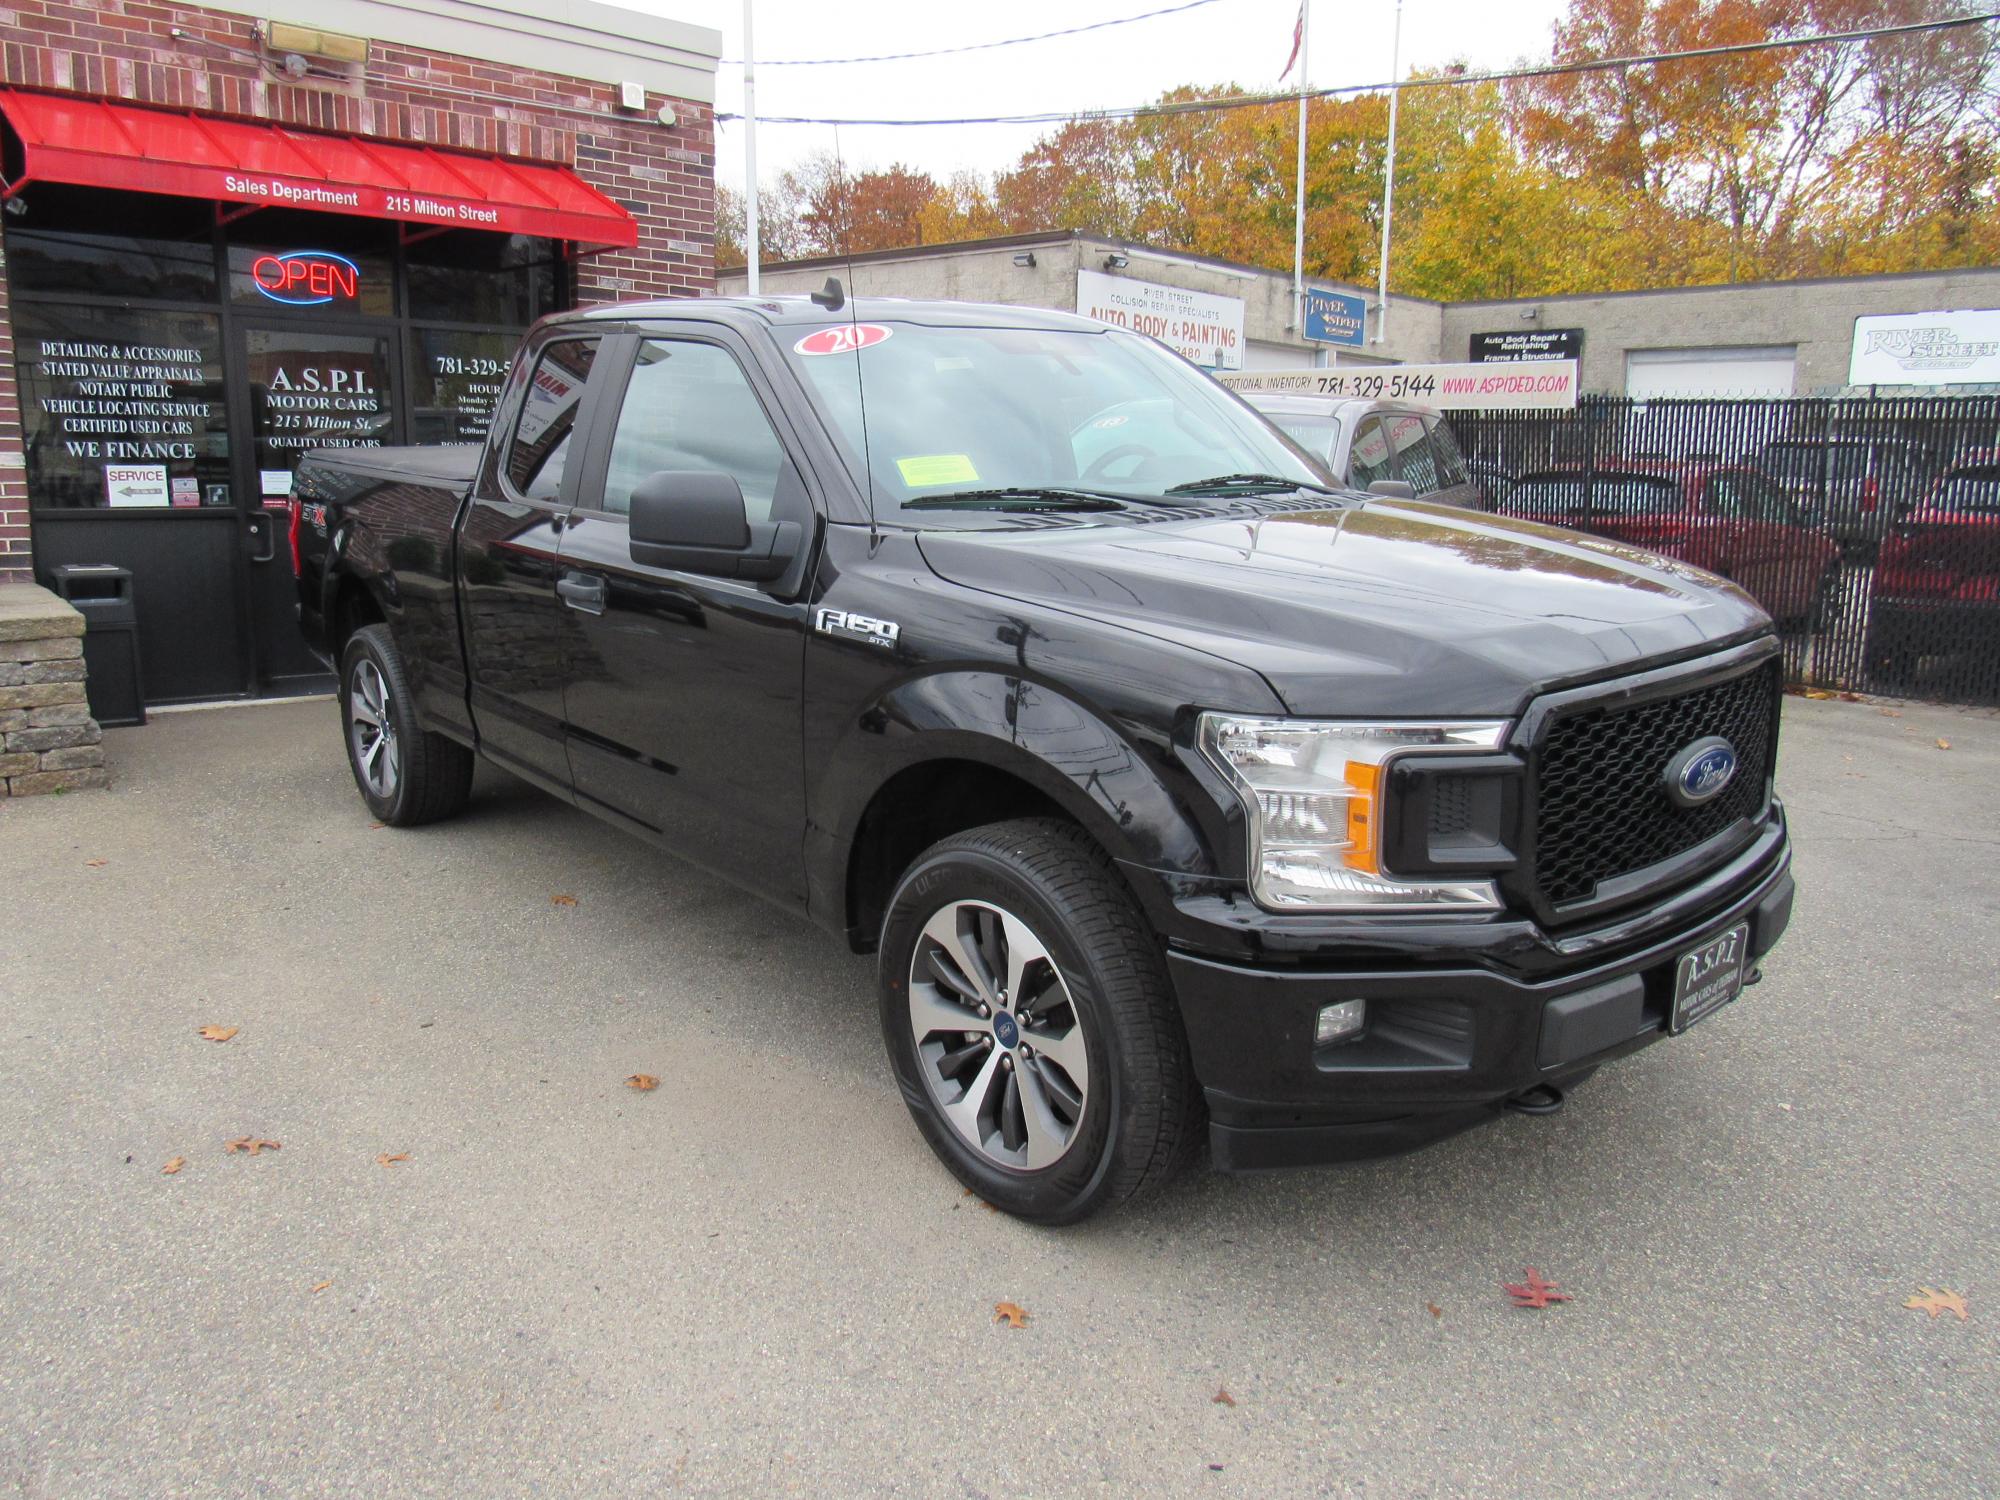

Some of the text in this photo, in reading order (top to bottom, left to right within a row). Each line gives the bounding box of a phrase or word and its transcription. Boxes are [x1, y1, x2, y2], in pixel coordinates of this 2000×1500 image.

[225, 176, 359, 206] Sales Department
[387, 196, 497, 223] 215 Milton Street
[253, 256, 356, 297] OPEN
[1143, 287, 1192, 304] RIVER STREET
[1110, 294, 1220, 321] COLLISION REPAIR SPECIALISTS
[1090, 306, 1236, 348] AUTO BODY & PAINTING
[1329, 316, 1361, 329] STREET
[826, 326, 865, 351] 20
[1484, 333, 1567, 345] Auto Body Repair &
[1501, 341, 1549, 351] Refinishing
[1864, 328, 1959, 359] RIVER
[41, 342, 202, 363] DETAILING & ACCESSORIES
[1484, 351, 1564, 362] Frame & Structural
[1911, 342, 2000, 359] STREET
[42, 361, 203, 381] STATED VALUE APPRAISALS
[437, 357, 511, 376] 781-329-5
[271, 367, 374, 394] A.S.P.I.
[469, 384, 500, 394] HOUR
[1267, 376, 1311, 389] INVENTORY
[1317, 375, 1435, 397] 781-329-5144
[1442, 376, 1568, 394] WWW.ASPIDED.COM
[79, 382, 173, 398] NOTARY PUBLIC
[42, 400, 210, 417] VEHICLE LOCATING SERVICE
[266, 395, 378, 412] MOTOR CARS
[458, 396, 488, 406] Monday
[63, 419, 193, 435] CERTIFIED USED CARS
[275, 415, 300, 428] 215
[304, 416, 351, 430] Milton
[356, 417, 372, 430] St.
[459, 427, 487, 435] 9:00am
[66, 442, 196, 459] WE FINANCE
[269, 437, 381, 449] QUALITY USED CARS
[109, 471, 164, 481] SERVICE
[868, 636, 891, 648] STX
